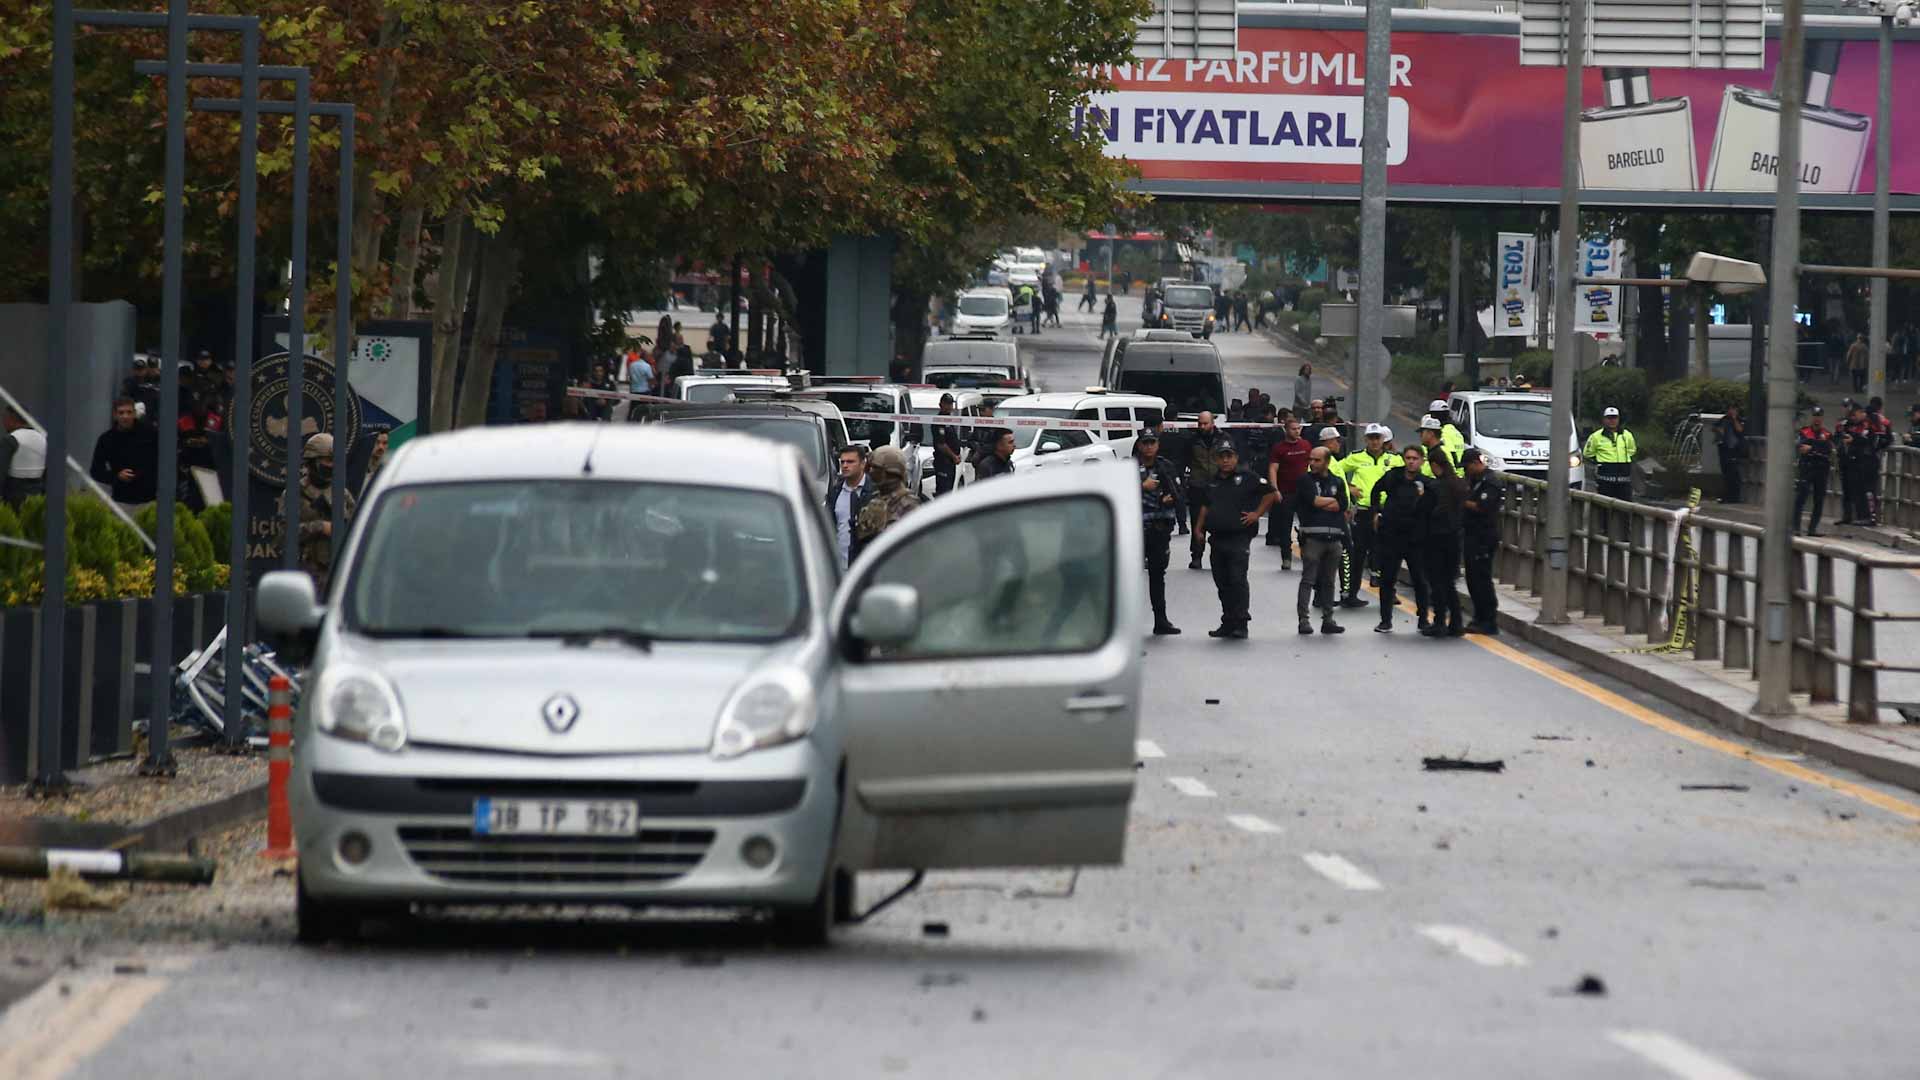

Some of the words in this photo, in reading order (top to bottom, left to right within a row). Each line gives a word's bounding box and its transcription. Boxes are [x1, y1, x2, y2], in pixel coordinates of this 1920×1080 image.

[1186, 50, 1412, 87] PARFÜMLR
[1135, 107, 1391, 148] FİYATLARL
[1608, 148, 1664, 169] BARGELLO
[1751, 152, 1821, 185] BARLO
[1511, 448, 1550, 457] POLİS
[540, 806, 567, 828] TP
